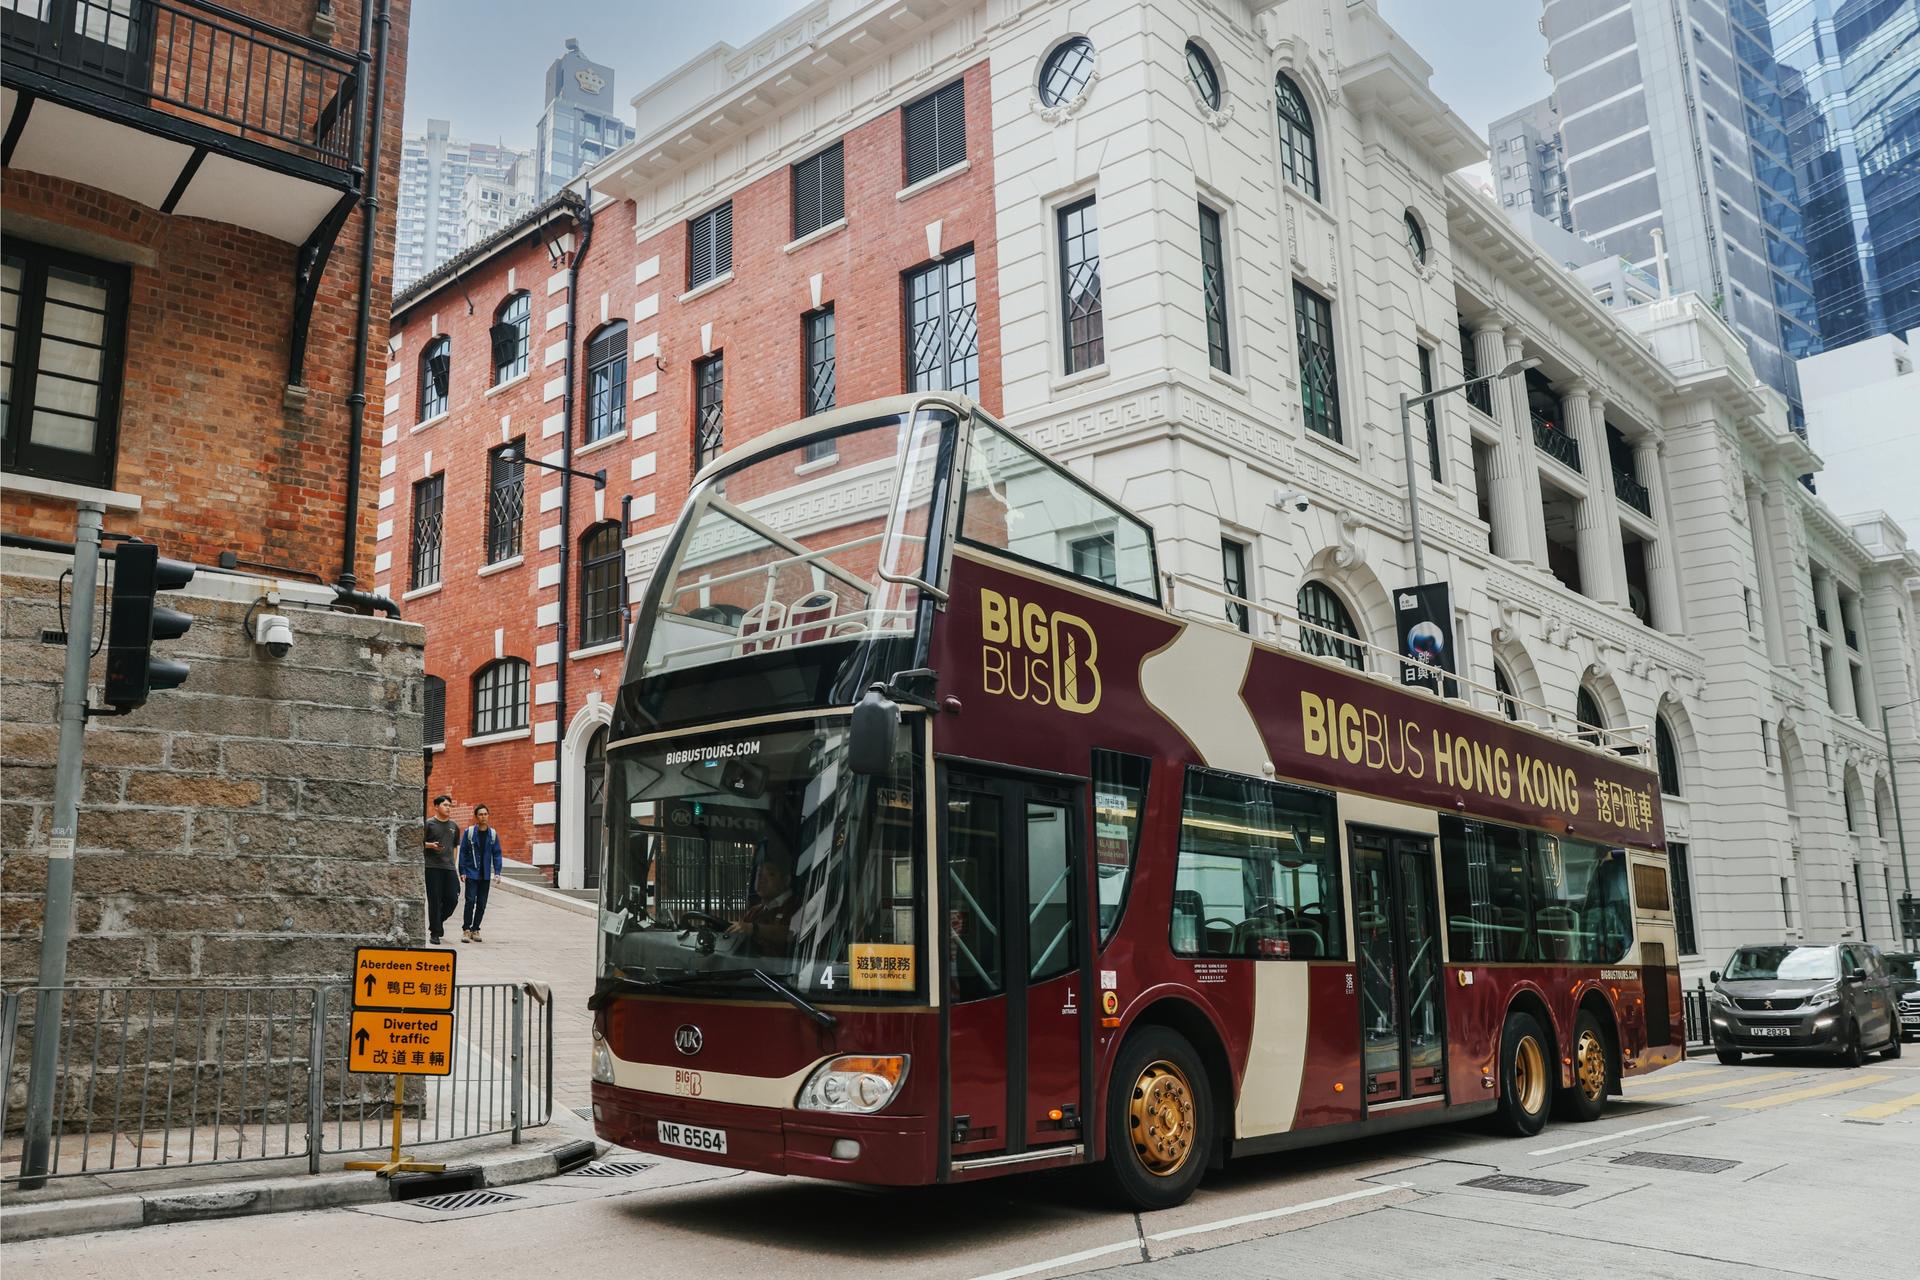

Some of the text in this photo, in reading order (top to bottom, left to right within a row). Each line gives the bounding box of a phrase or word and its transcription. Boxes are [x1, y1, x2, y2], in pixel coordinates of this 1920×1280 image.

[981, 587, 1049, 654] BIG
[982, 645, 1051, 706] BUS
[666, 740, 760, 765] BIGBUSTOURS.COM
[1433, 728, 1511, 801] HONG
[1516, 752, 1580, 816] KONG
[360, 959, 451, 972] Aberdeen Street
[856, 956, 911, 971] 遊覽服務
[820, 965, 835, 989] 4
[1600, 969, 1638, 980] BIGBUSTOURS.COM
[387, 981, 447, 997] 鴨巴甸街
[1063, 987, 1076, 1008] 上
[383, 1018, 438, 1031] Diverted
[389, 1032, 430, 1045] traffic
[373, 1049, 445, 1067] 改道車輛
[675, 1070, 690, 1083] BIG
[675, 1081, 690, 1095] BUS
[662, 1123, 722, 1151] NR 6564
